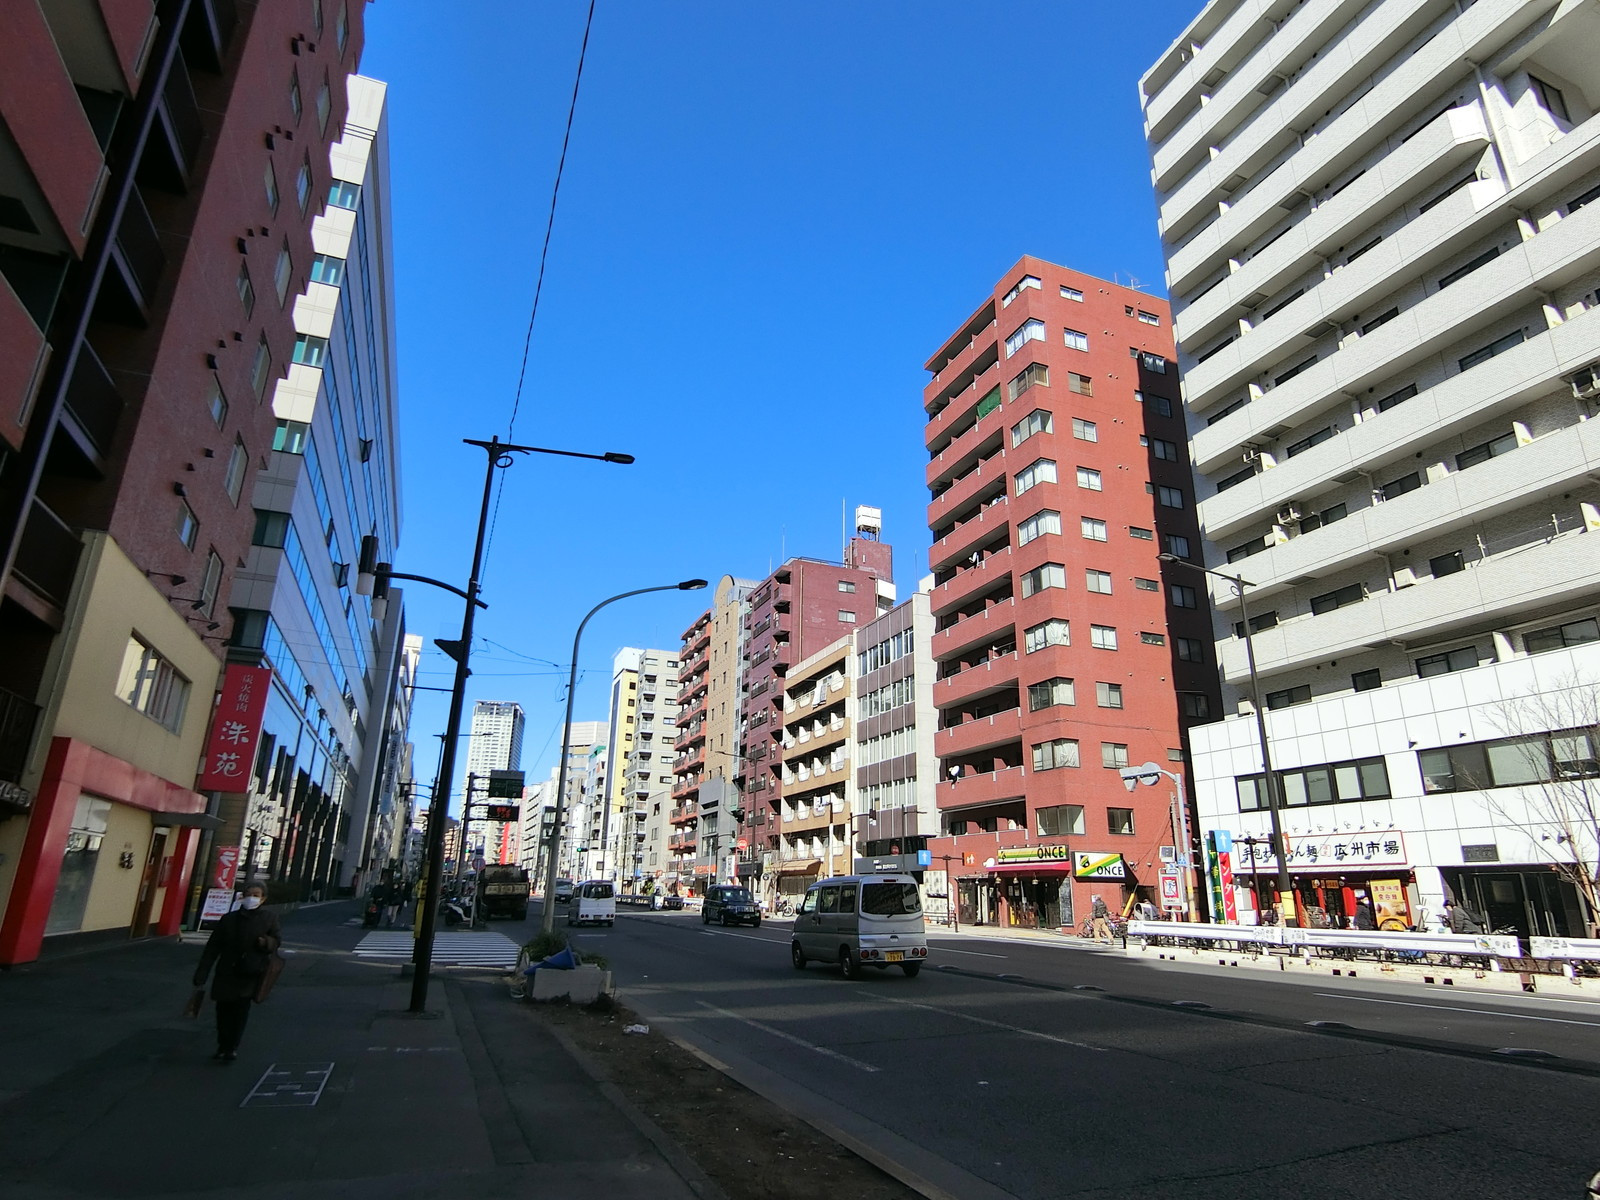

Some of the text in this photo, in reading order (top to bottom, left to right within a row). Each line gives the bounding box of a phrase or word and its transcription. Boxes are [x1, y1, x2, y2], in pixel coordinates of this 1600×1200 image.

[1037, 846, 1064, 859] ONCE
[1334, 840, 1400, 857] 広州市場
[1096, 865, 1123, 876] ONCE
